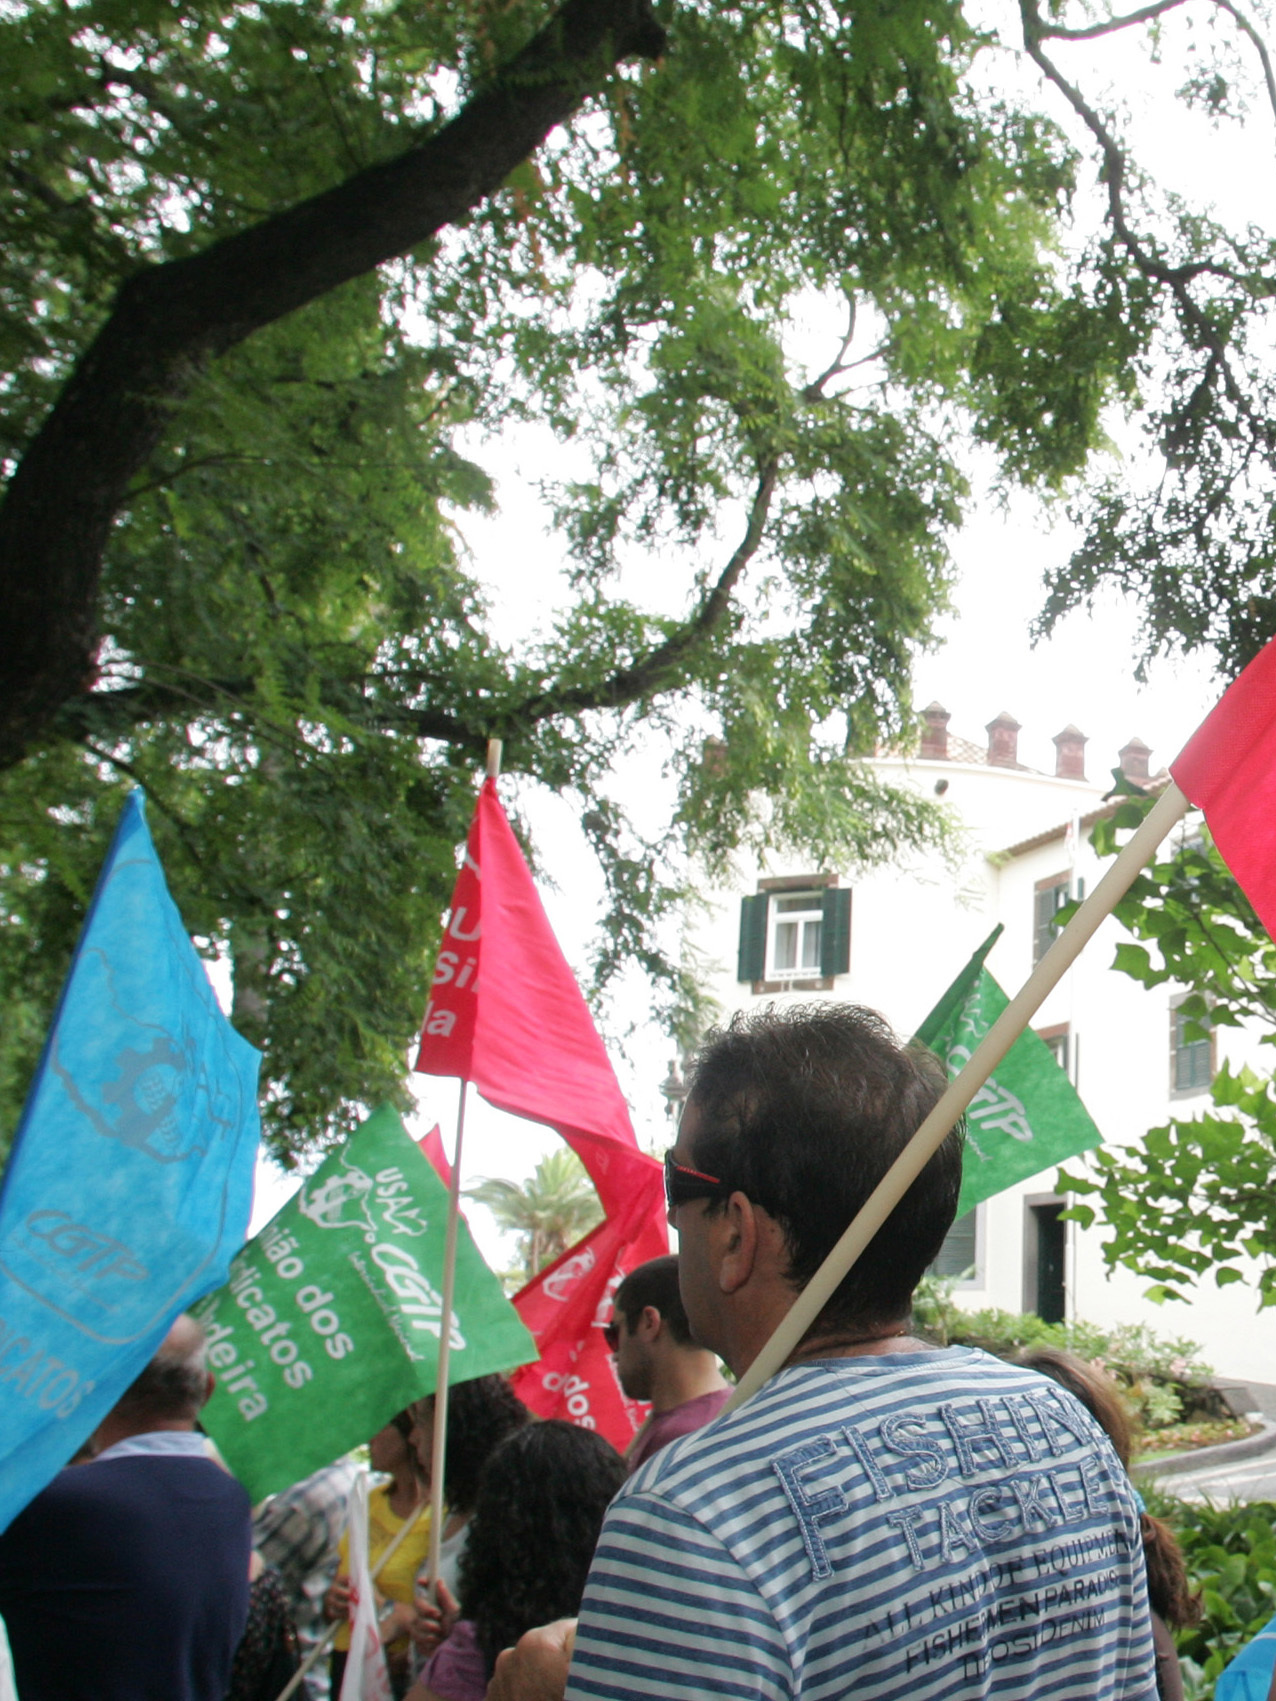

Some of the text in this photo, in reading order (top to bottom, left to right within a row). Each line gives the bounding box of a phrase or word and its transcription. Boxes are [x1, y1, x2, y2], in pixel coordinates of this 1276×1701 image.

[26, 1210, 150, 1281] CGTP
[296, 1285, 354, 1359] dos
[886, 1452, 1109, 1571] TACKLE
